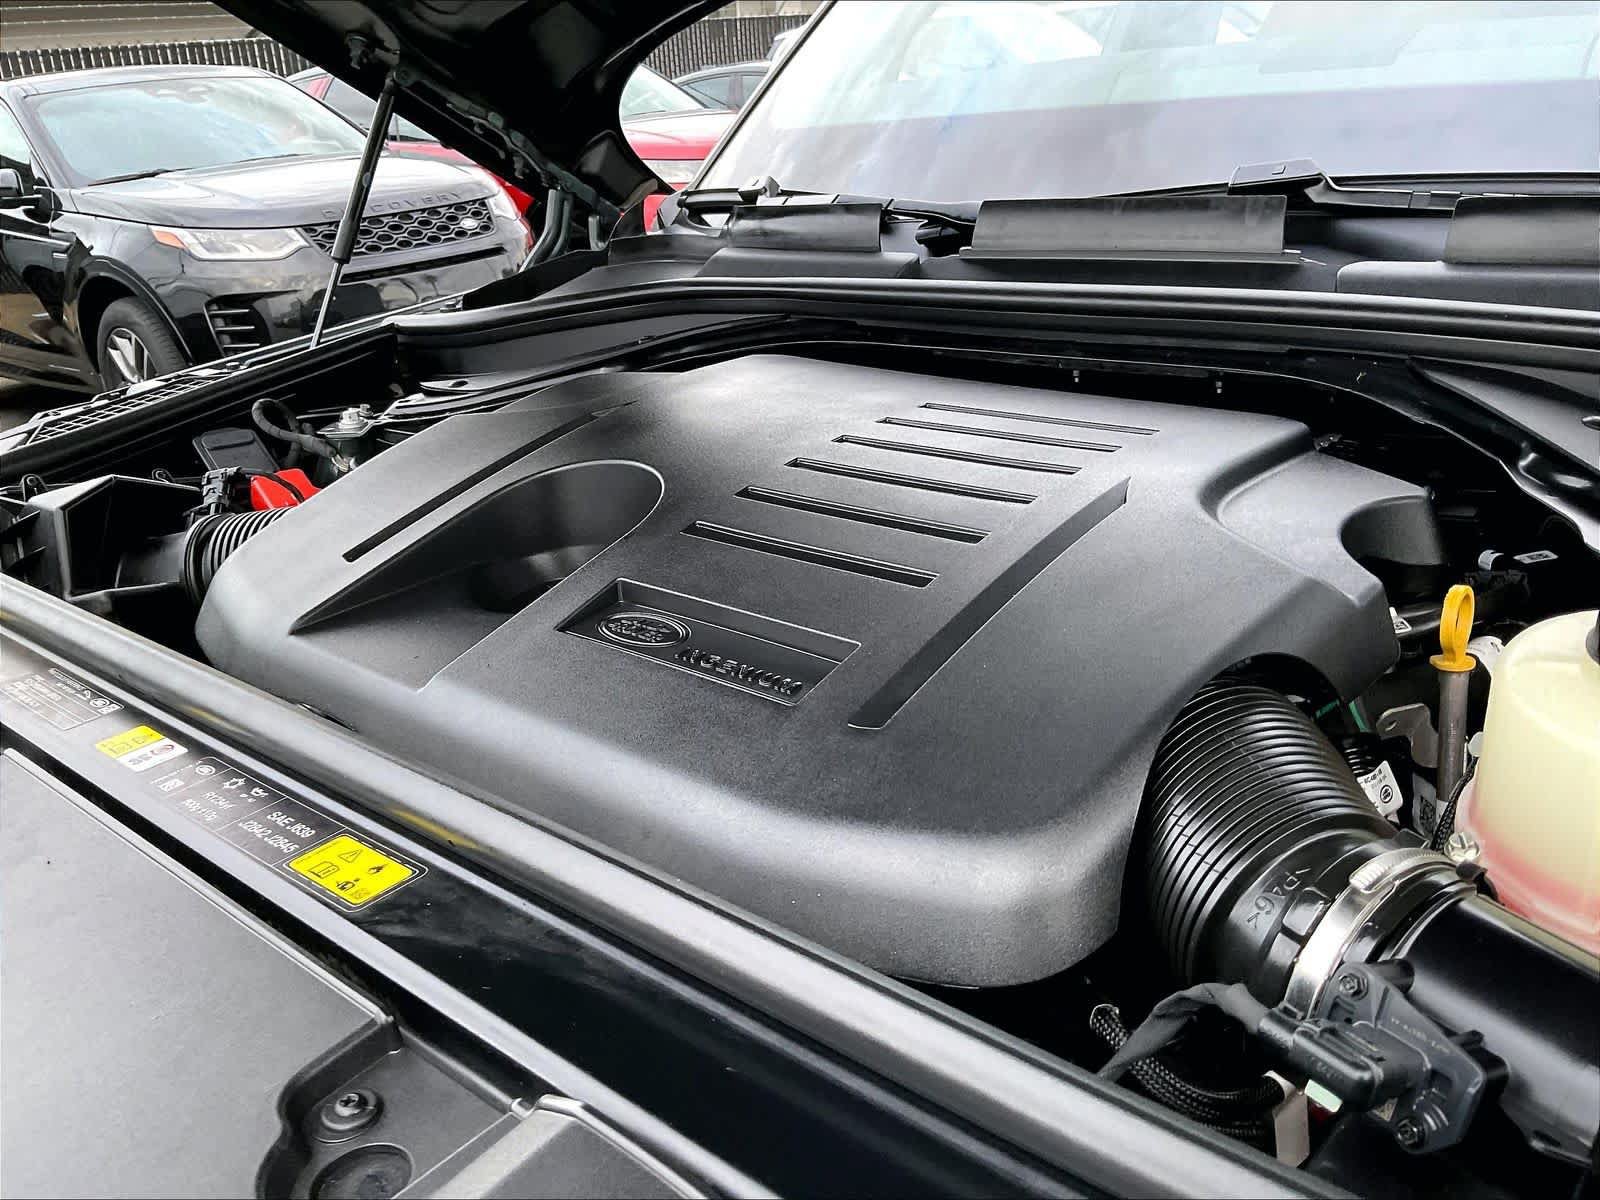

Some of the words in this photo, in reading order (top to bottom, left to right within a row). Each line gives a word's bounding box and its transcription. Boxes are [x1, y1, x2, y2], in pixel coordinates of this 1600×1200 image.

[319, 191, 462, 220] DICOVERY
[238, 819, 274, 838] J2842
[263, 834, 301, 854] J2845
[266, 811, 296, 828] SAE
[286, 822, 317, 839] J639
